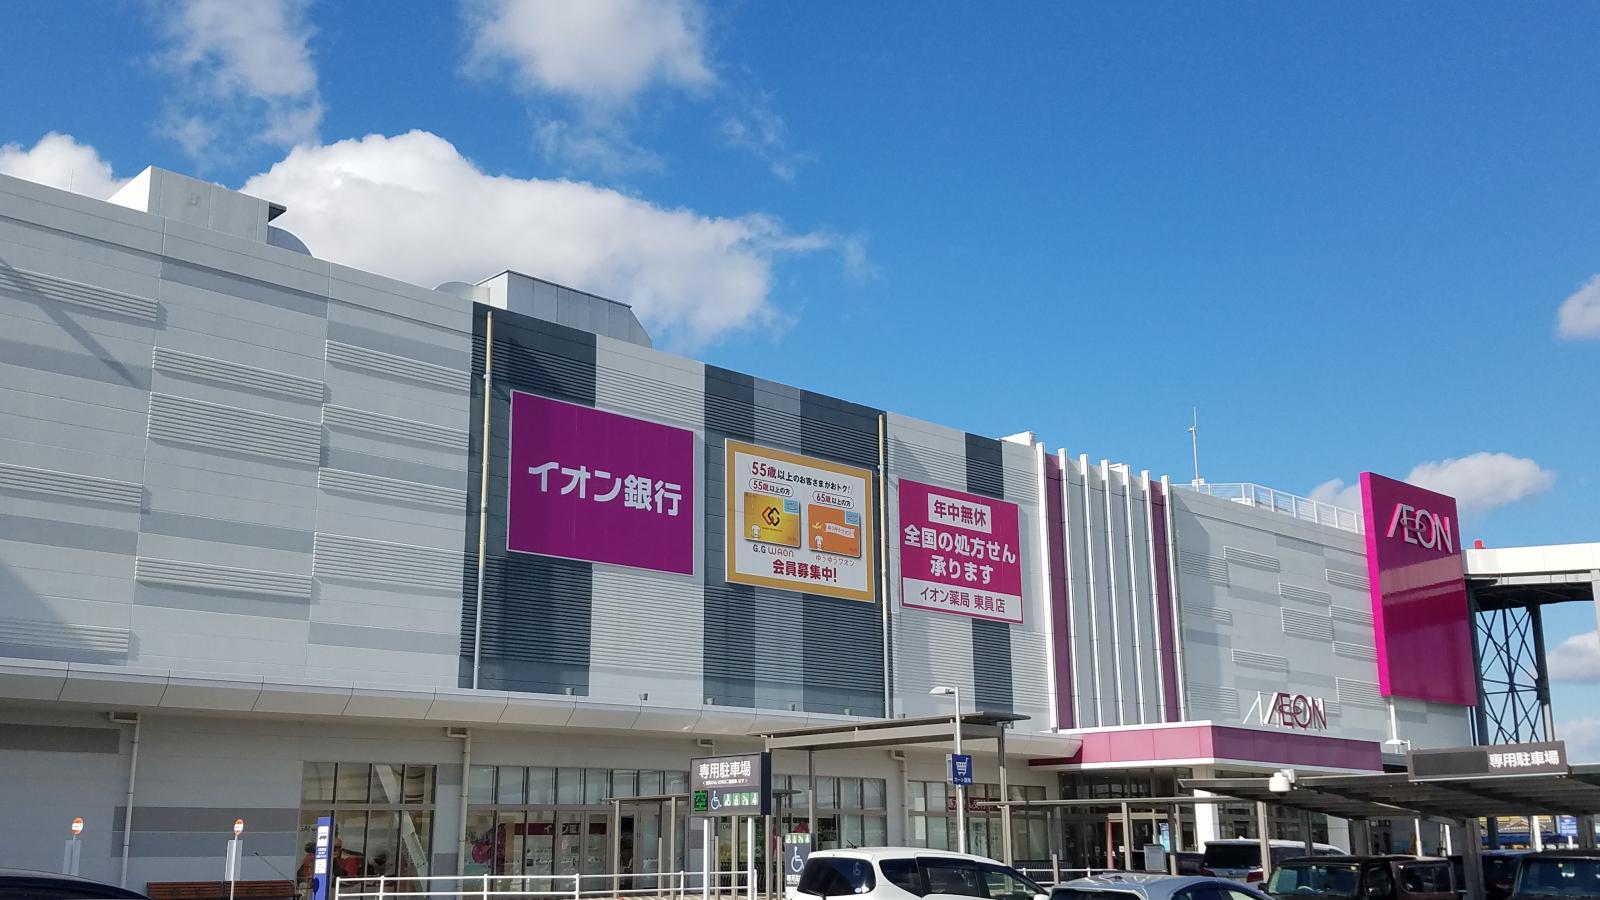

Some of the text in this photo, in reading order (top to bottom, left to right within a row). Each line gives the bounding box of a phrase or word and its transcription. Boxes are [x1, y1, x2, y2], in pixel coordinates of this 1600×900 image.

[528, 461, 682, 517] イオン銀行
[752, 481, 791, 496] 55歳以上の方
[816, 493, 852, 508] 65歳以上の方
[933, 499, 987, 528] 年中無休
[904, 523, 1016, 564] 全国の処方せん
[772, 558, 838, 583] 会員募集中!
[815, 553, 856, 567] ゆうゆうワオン
[930, 554, 994, 585] 承ります
[920, 586, 1006, 614] イオン薬局 東員店
[698, 760, 752, 779] 専用駐車場
[1488, 749, 1560, 769] 専用駐車場
